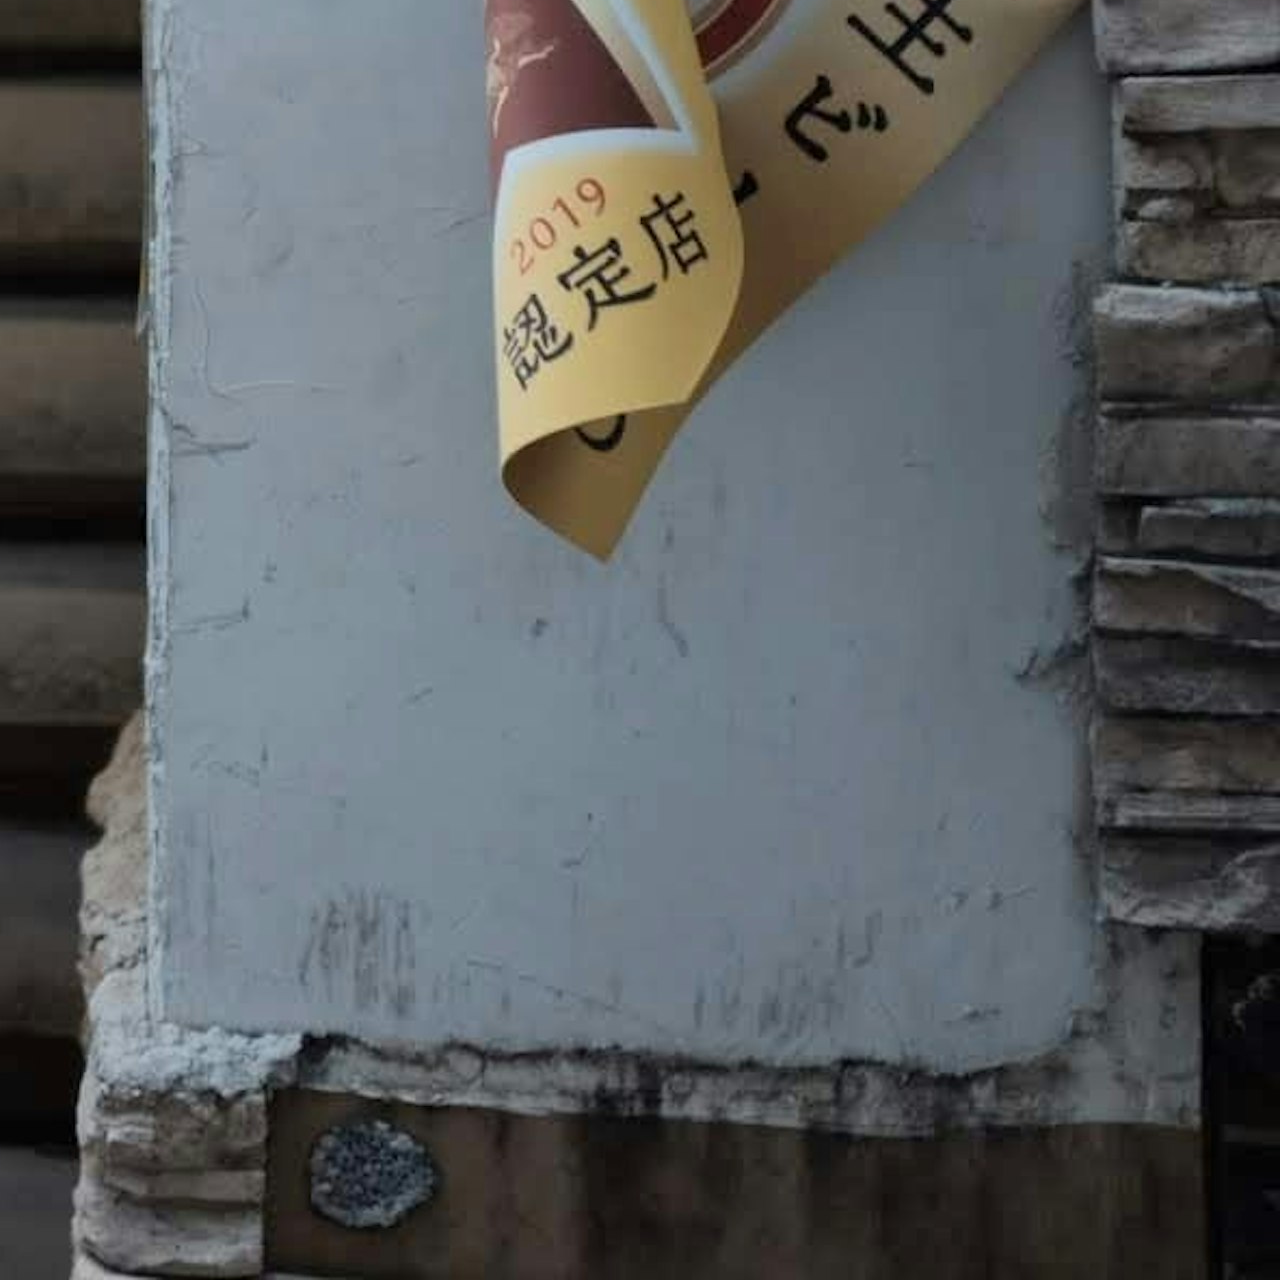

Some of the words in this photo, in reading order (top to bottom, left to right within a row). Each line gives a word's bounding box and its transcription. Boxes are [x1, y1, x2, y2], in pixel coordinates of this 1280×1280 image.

[502, 190, 709, 391] 認定店
[512, 177, 607, 275] 2019
